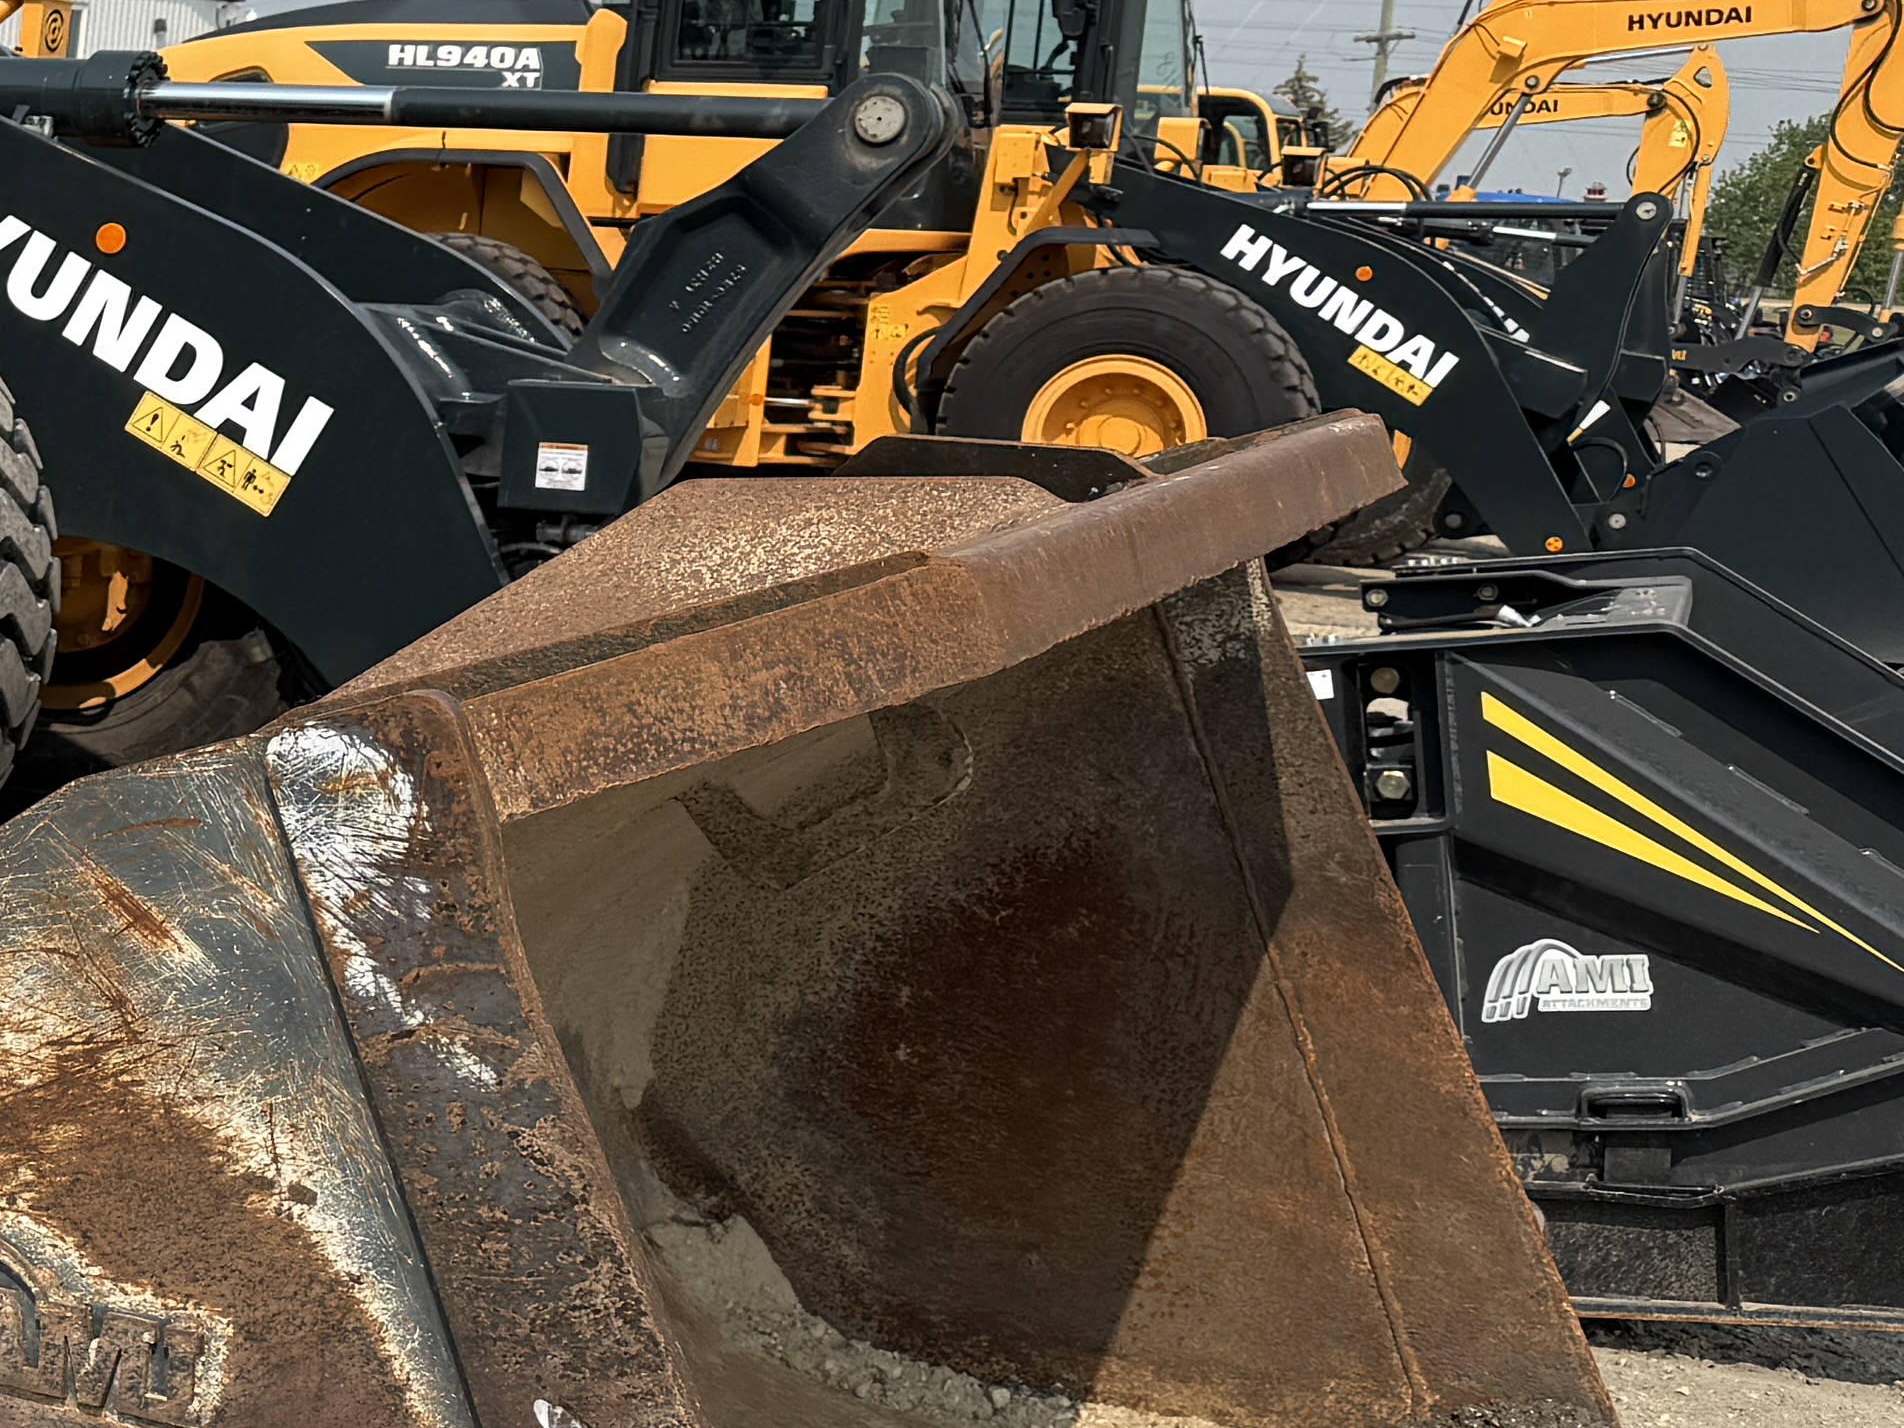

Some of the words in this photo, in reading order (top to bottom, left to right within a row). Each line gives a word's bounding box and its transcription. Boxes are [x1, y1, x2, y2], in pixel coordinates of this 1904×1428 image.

[1627, 5, 1752, 32] HYUNDAI
[388, 44, 540, 70] HL940A
[501, 71, 541, 88] XT
[1220, 223, 1460, 389] HYUNDAI
[1536, 958, 1649, 994] AMI
[1542, 997, 1649, 1009] ATTACHMENTS
